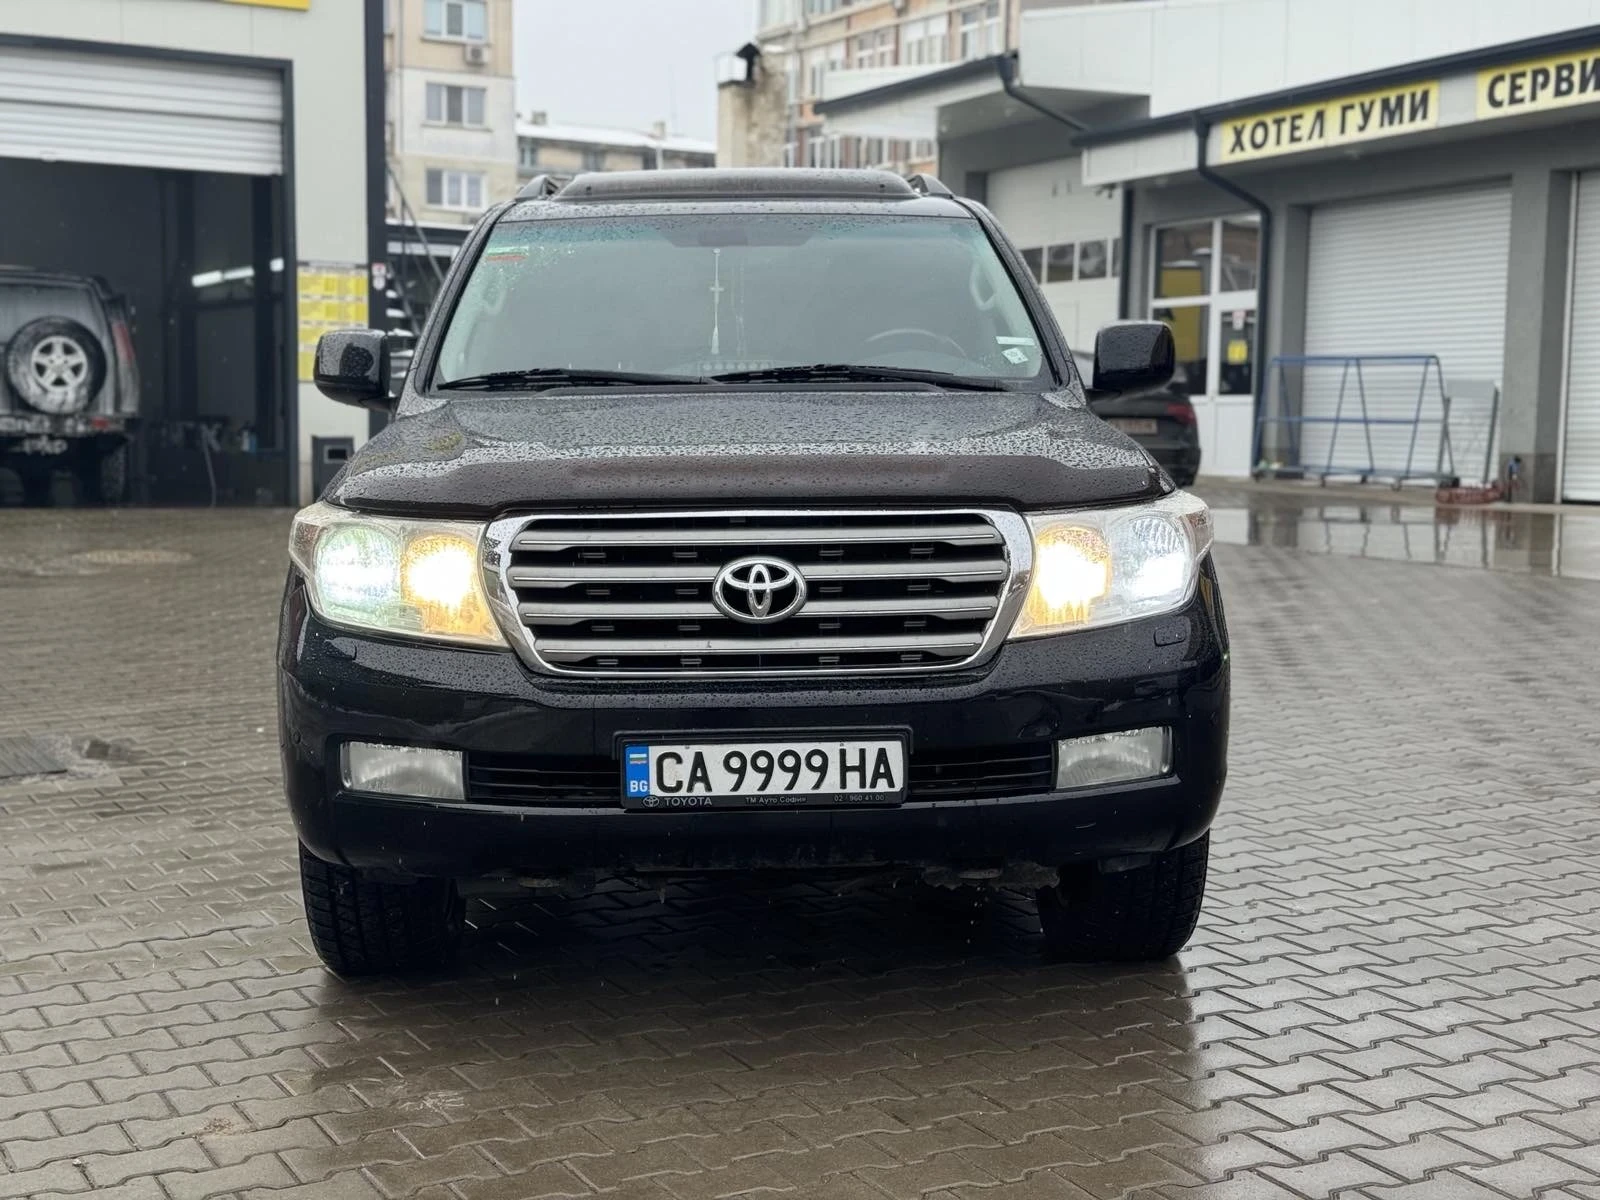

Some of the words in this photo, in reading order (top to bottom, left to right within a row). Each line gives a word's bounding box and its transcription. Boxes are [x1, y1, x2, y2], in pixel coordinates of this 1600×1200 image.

[1230, 109, 1325, 154] ХОТЕЛ
[1340, 89, 1429, 135] ГУМИ
[656, 751, 713, 793] CA
[722, 748, 829, 792] 9999
[839, 747, 895, 790] HA
[630, 780, 648, 793] BG
[664, 797, 713, 806] TOYOTA
